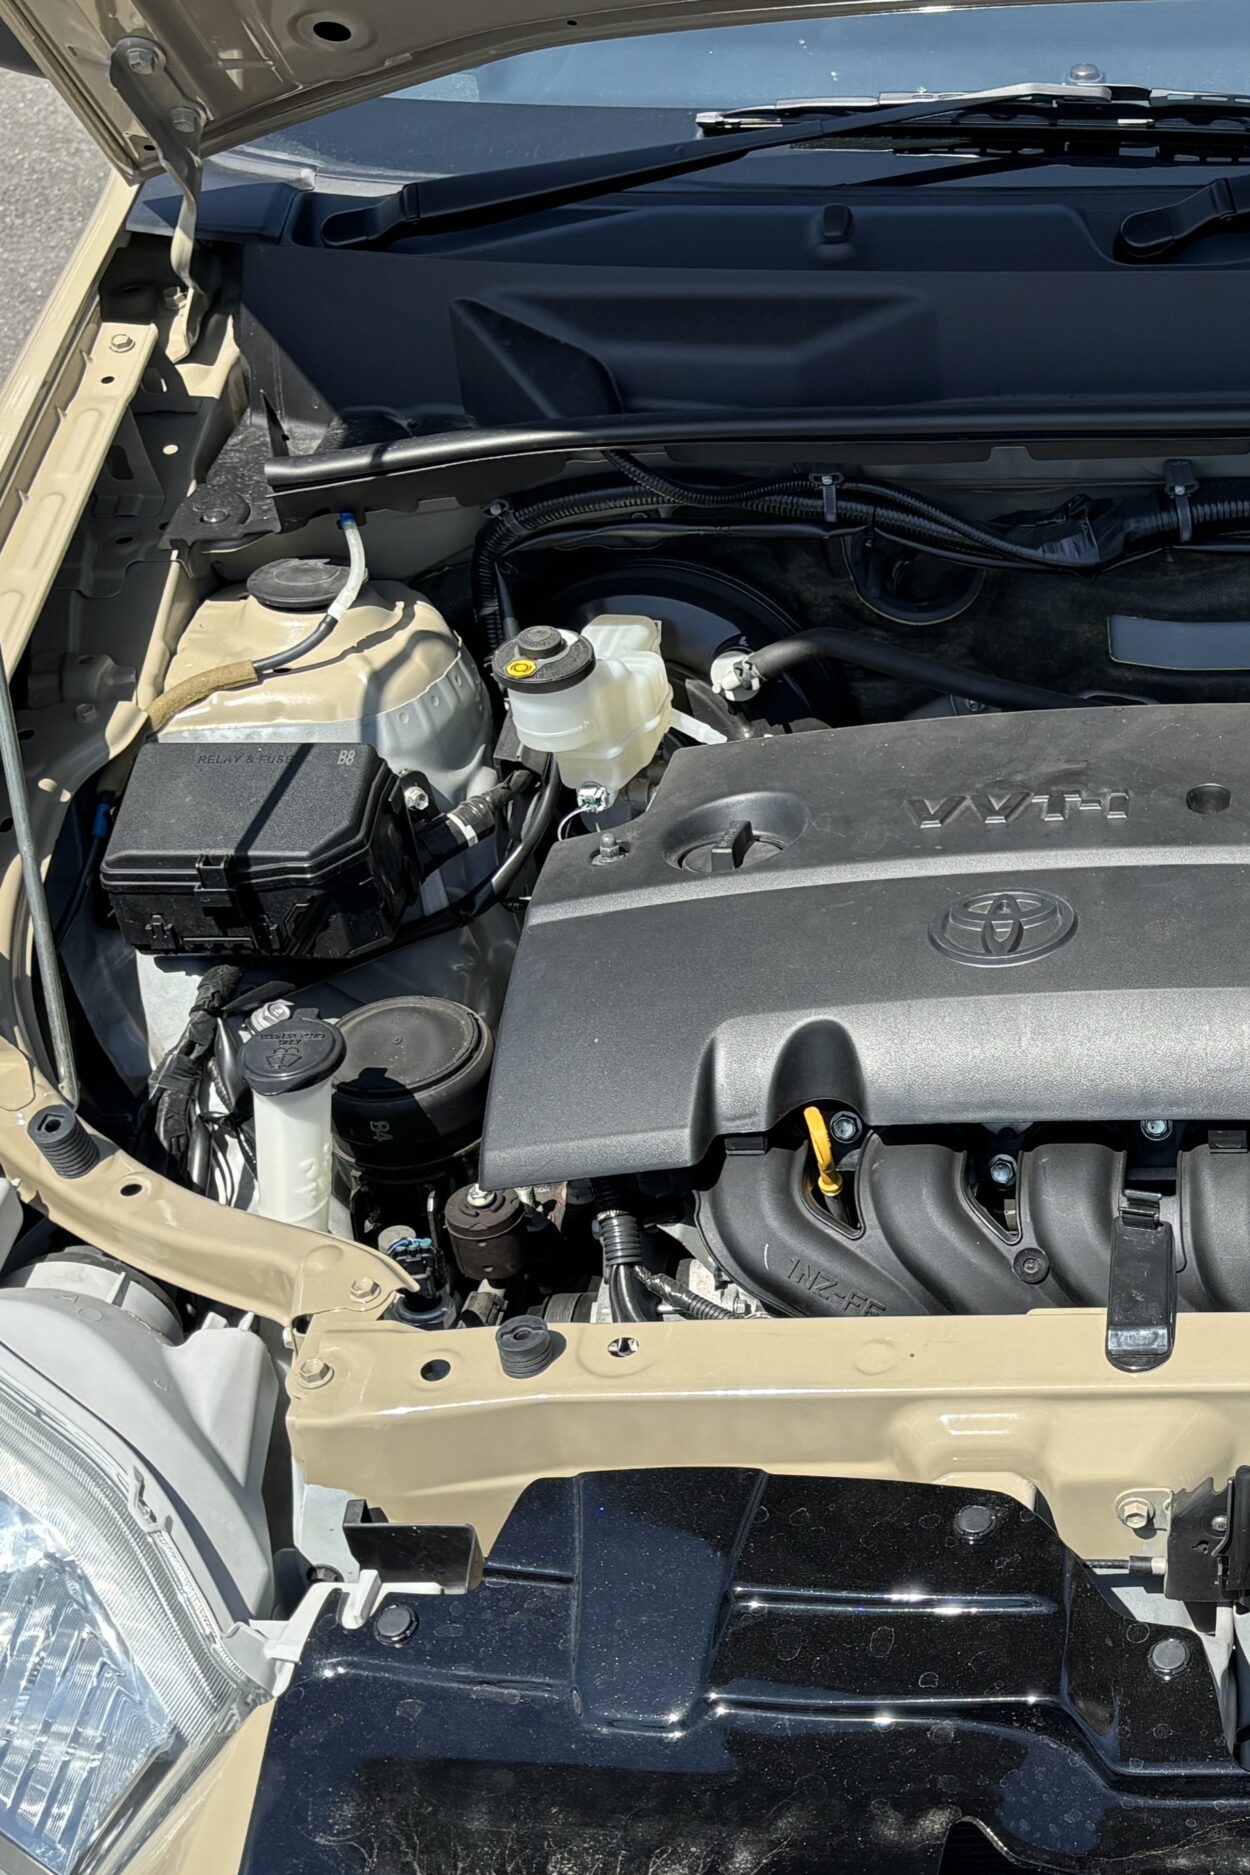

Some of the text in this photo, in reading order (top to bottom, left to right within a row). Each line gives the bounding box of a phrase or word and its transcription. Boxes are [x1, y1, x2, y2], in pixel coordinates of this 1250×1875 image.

[197, 754, 295, 764] RELAY & FUSE
